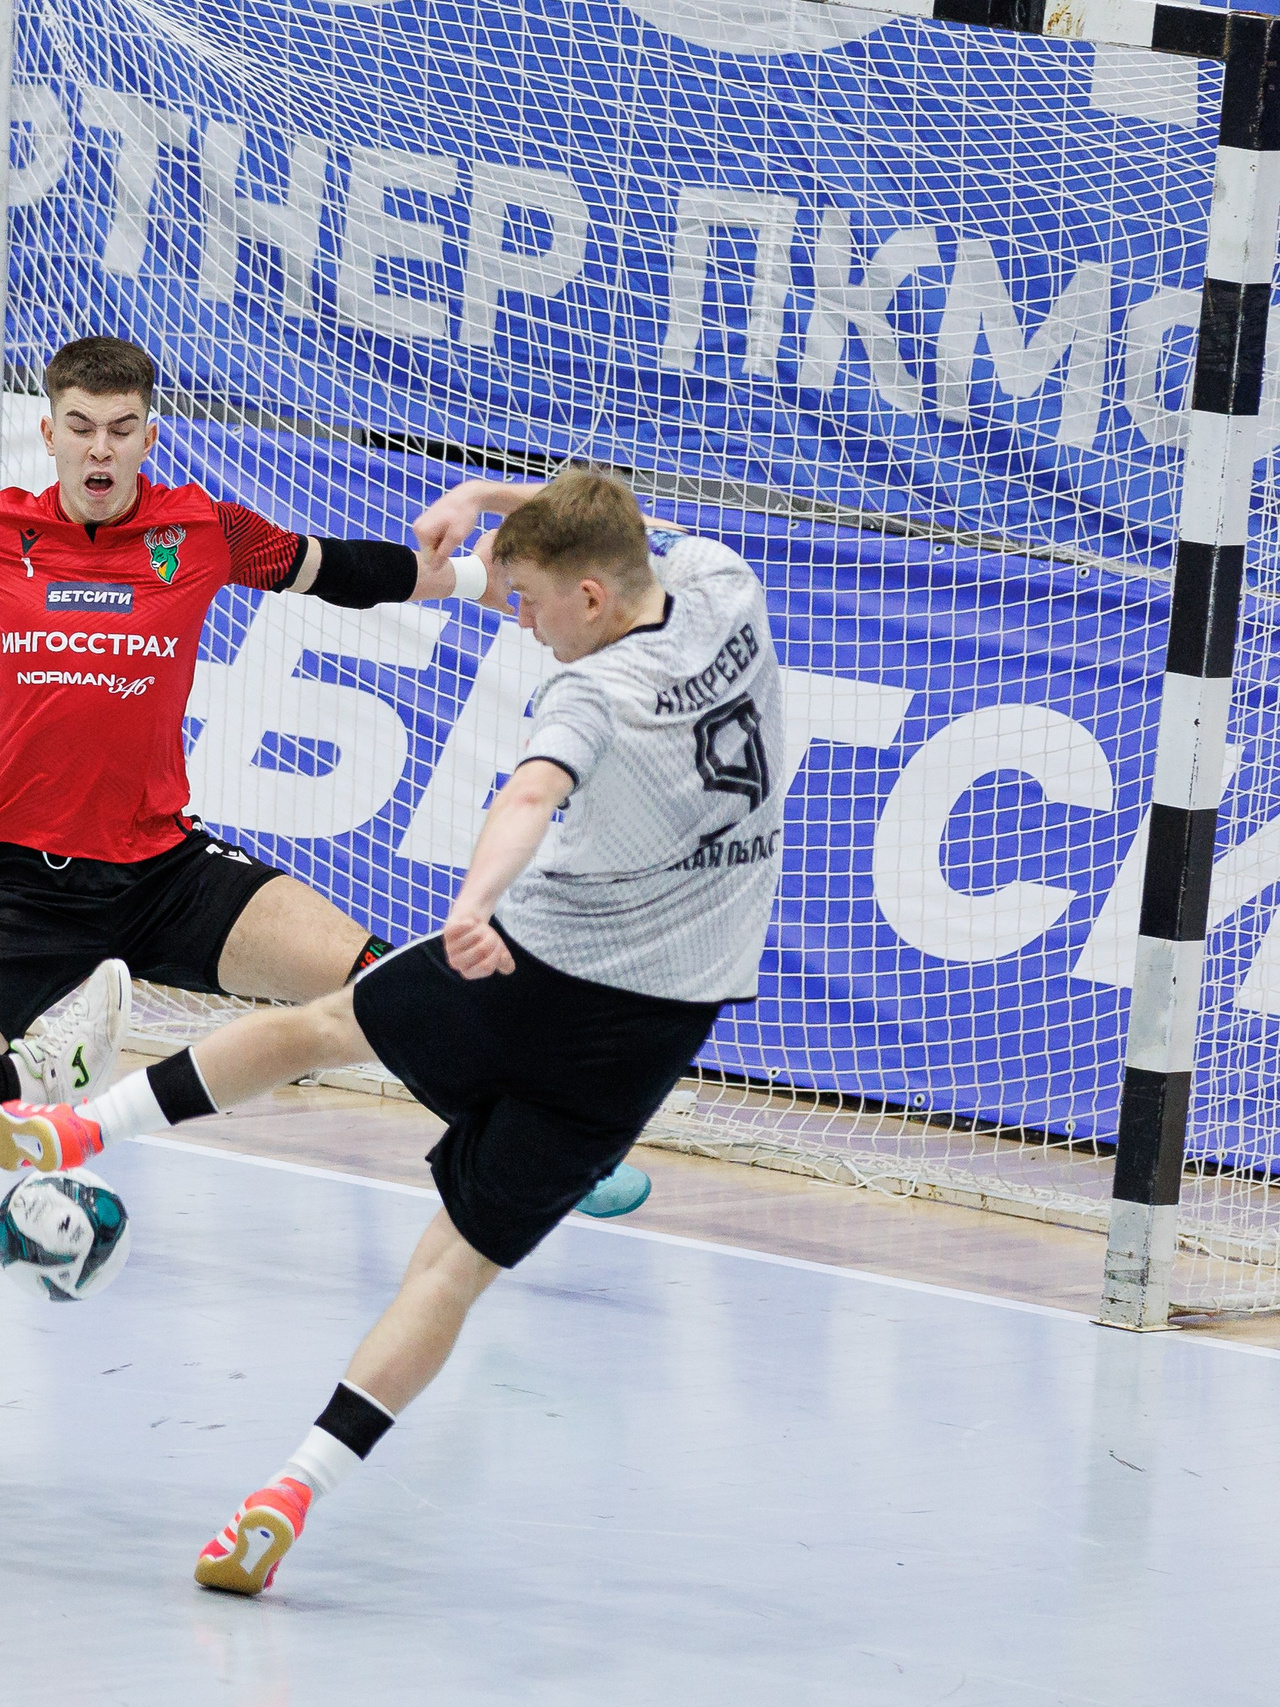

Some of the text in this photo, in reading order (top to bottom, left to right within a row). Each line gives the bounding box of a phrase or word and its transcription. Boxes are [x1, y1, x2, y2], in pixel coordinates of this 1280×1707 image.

[48, 590, 132, 606] БЕТСИТИ
[2, 631, 179, 658] ИНГОССТРАХ
[694, 691, 771, 843] 9
